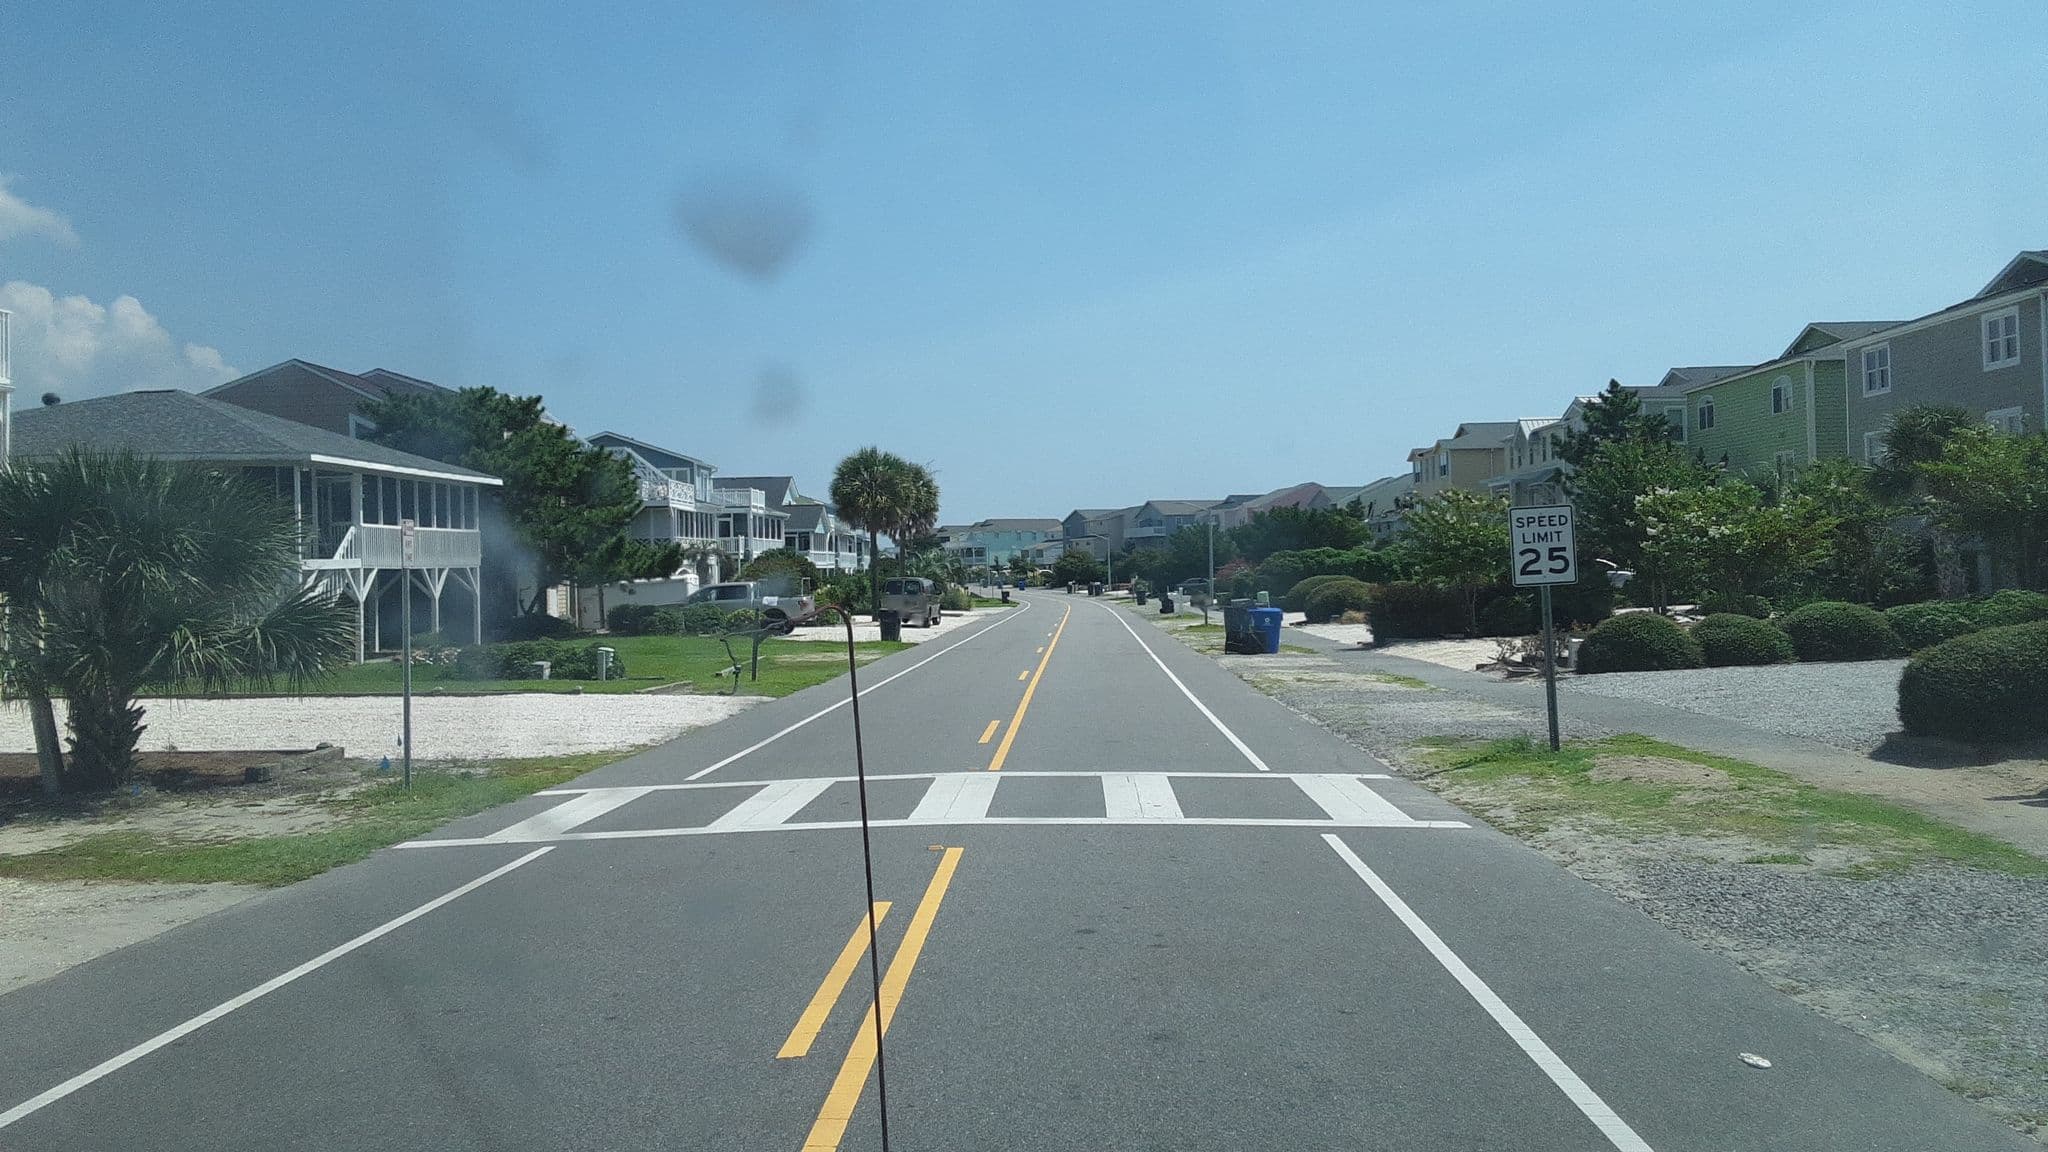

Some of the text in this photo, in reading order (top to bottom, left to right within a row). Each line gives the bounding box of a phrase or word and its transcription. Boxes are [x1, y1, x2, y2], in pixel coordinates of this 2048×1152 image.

[1516, 514, 1568, 528] SPEED
[1522, 531, 1562, 544] LIMIT
[1519, 547, 1570, 576] 25
